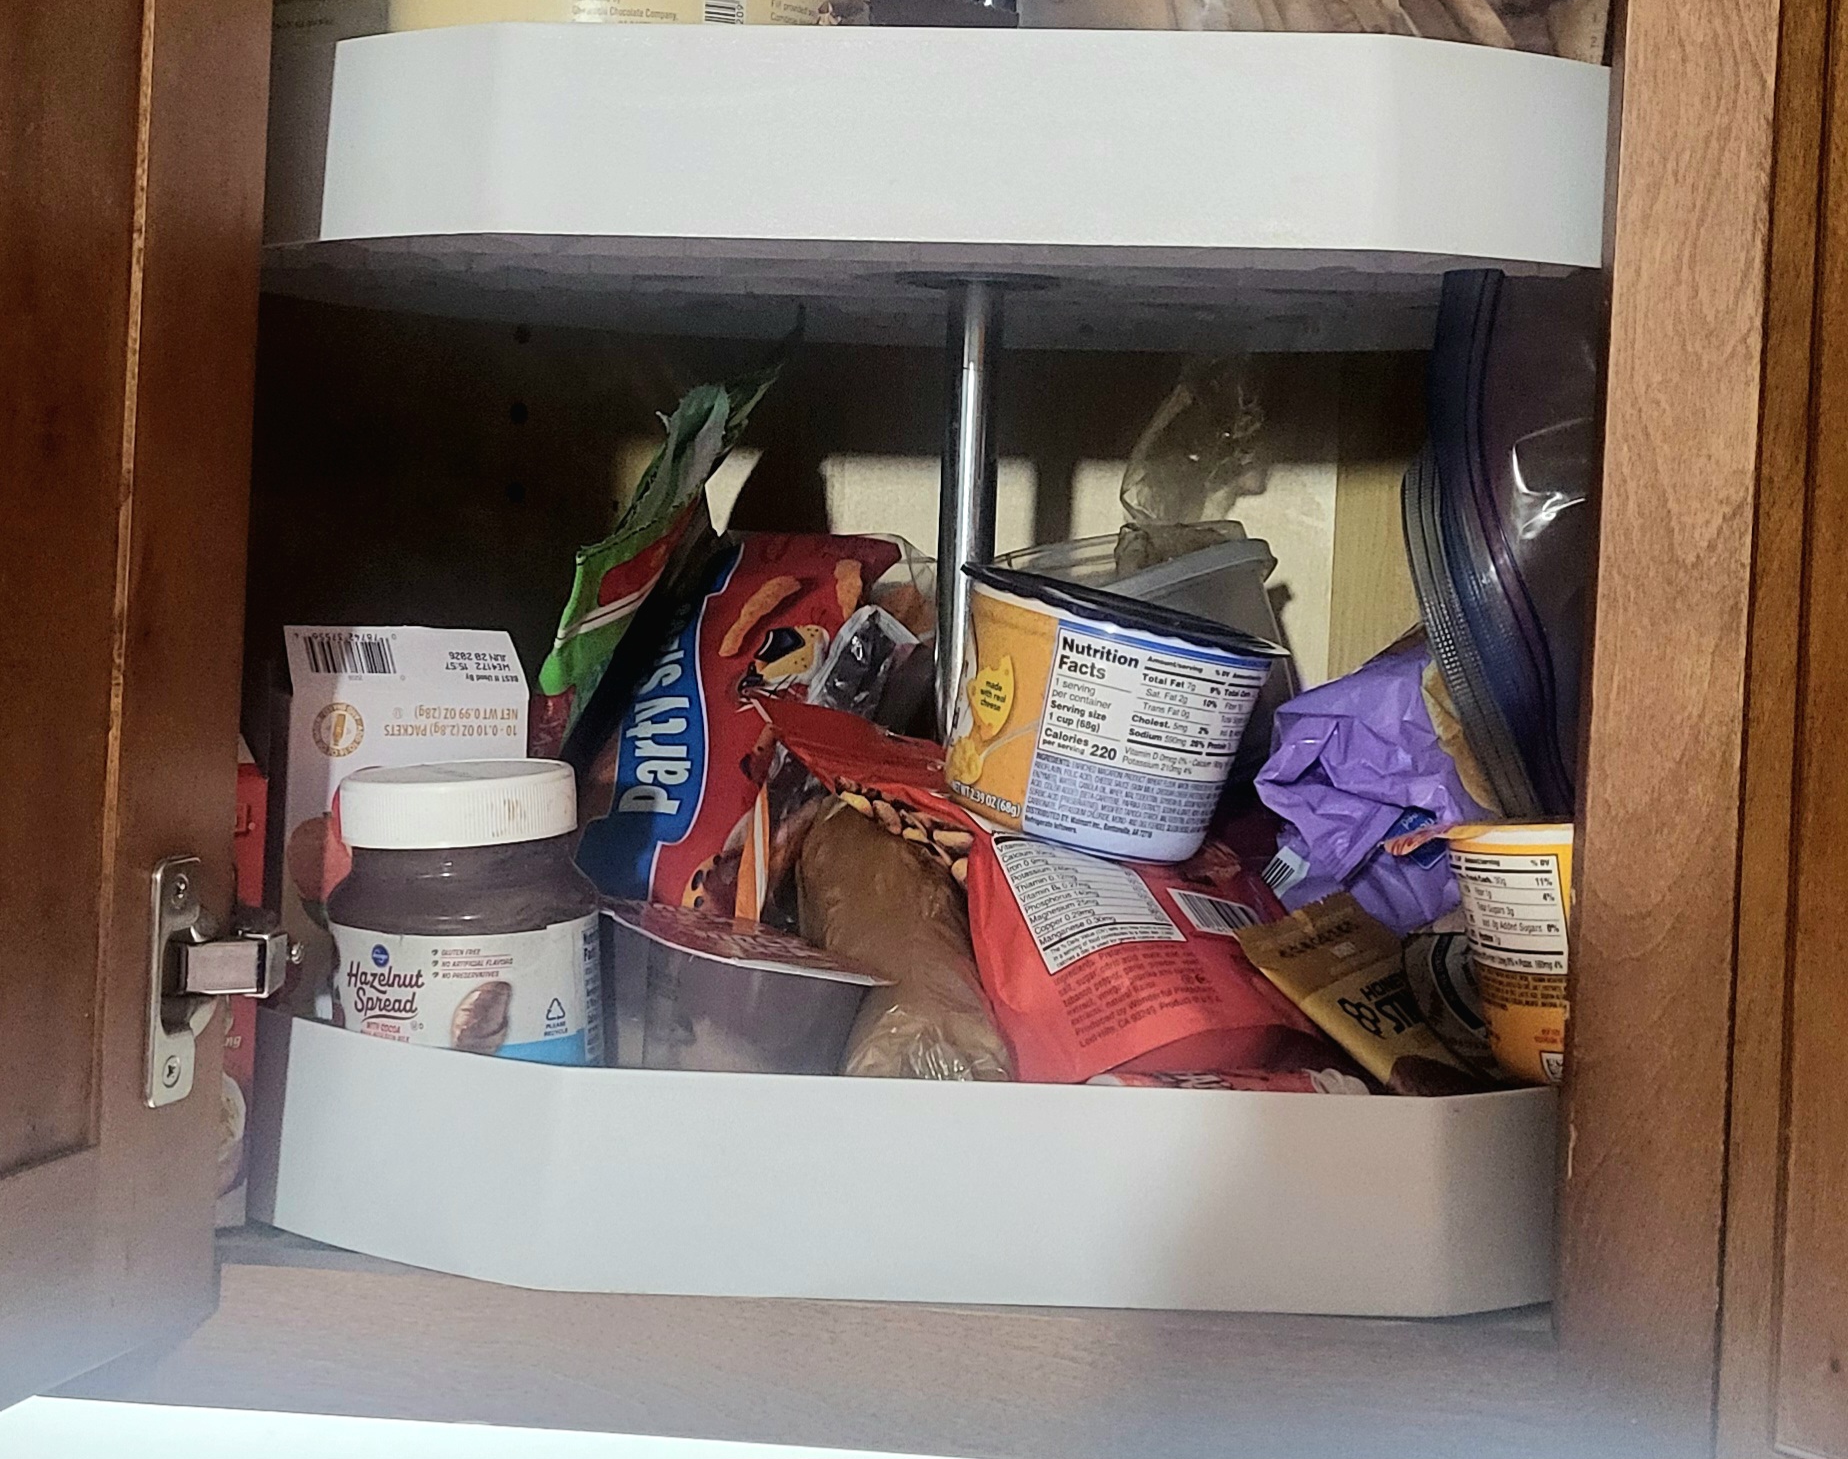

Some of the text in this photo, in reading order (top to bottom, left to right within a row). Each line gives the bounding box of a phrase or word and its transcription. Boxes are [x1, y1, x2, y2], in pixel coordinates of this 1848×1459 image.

[1062, 636, 1139, 668] Nutrition
[1058, 655, 1106, 680] Facts
[1147, 656, 1203, 673] Amount/serving
[465, 673, 475, 682] By
[501, 674, 519, 684] BEST
[985, 680, 1003, 692] made
[1142, 673, 1196, 692] Total Fat 7g
[980, 689, 1006, 703] with real
[1062, 680, 1096, 696] serving
[980, 699, 1001, 712] cheese
[1052, 689, 1112, 710] per container
[1146, 688, 1217, 709] Sat. Fat 2g 10%
[414, 705, 519, 720] NET WT 0.99 OZ (28g)
[1051, 700, 1107, 721] Serving size
[1143, 702, 1190, 720] Trans Fat 0g
[384, 724, 518, 739] 10 0.10 OZ (2.8g) PACKETS
[1056, 715, 1100, 733] cup (68g)
[1131, 715, 1188, 733] Cholest. 5mg
[1129, 728, 1162, 741] Sodium
[1042, 739, 1085, 755] per serving
[1044, 727, 1117, 761] Calories 220
[1124, 746, 1151, 758] Vitamin
[619, 696, 691, 815] Party
[1122, 756, 1159, 771] Potassium
[970, 787, 1021, 818] 2.39 OZ (68g)
[1002, 849, 1034, 863] Calcium
[1007, 862, 1022, 873] Iron
[1011, 866, 1051, 884] Potassium
[1015, 877, 1047, 893] Thiamin
[1535, 877, 1552, 886] 11%
[1020, 887, 1050, 903] Vitamin
[1025, 891, 1072, 914] Phosphorus
[1029, 901, 1075, 925] Magnesium
[1034, 917, 1063, 936] Copper
[1039, 920, 1085, 946] Manganese
[347, 961, 425, 994] Hazelnut
[354, 987, 418, 1019] Spread
[545, 1020, 566, 1029] PLEASE
